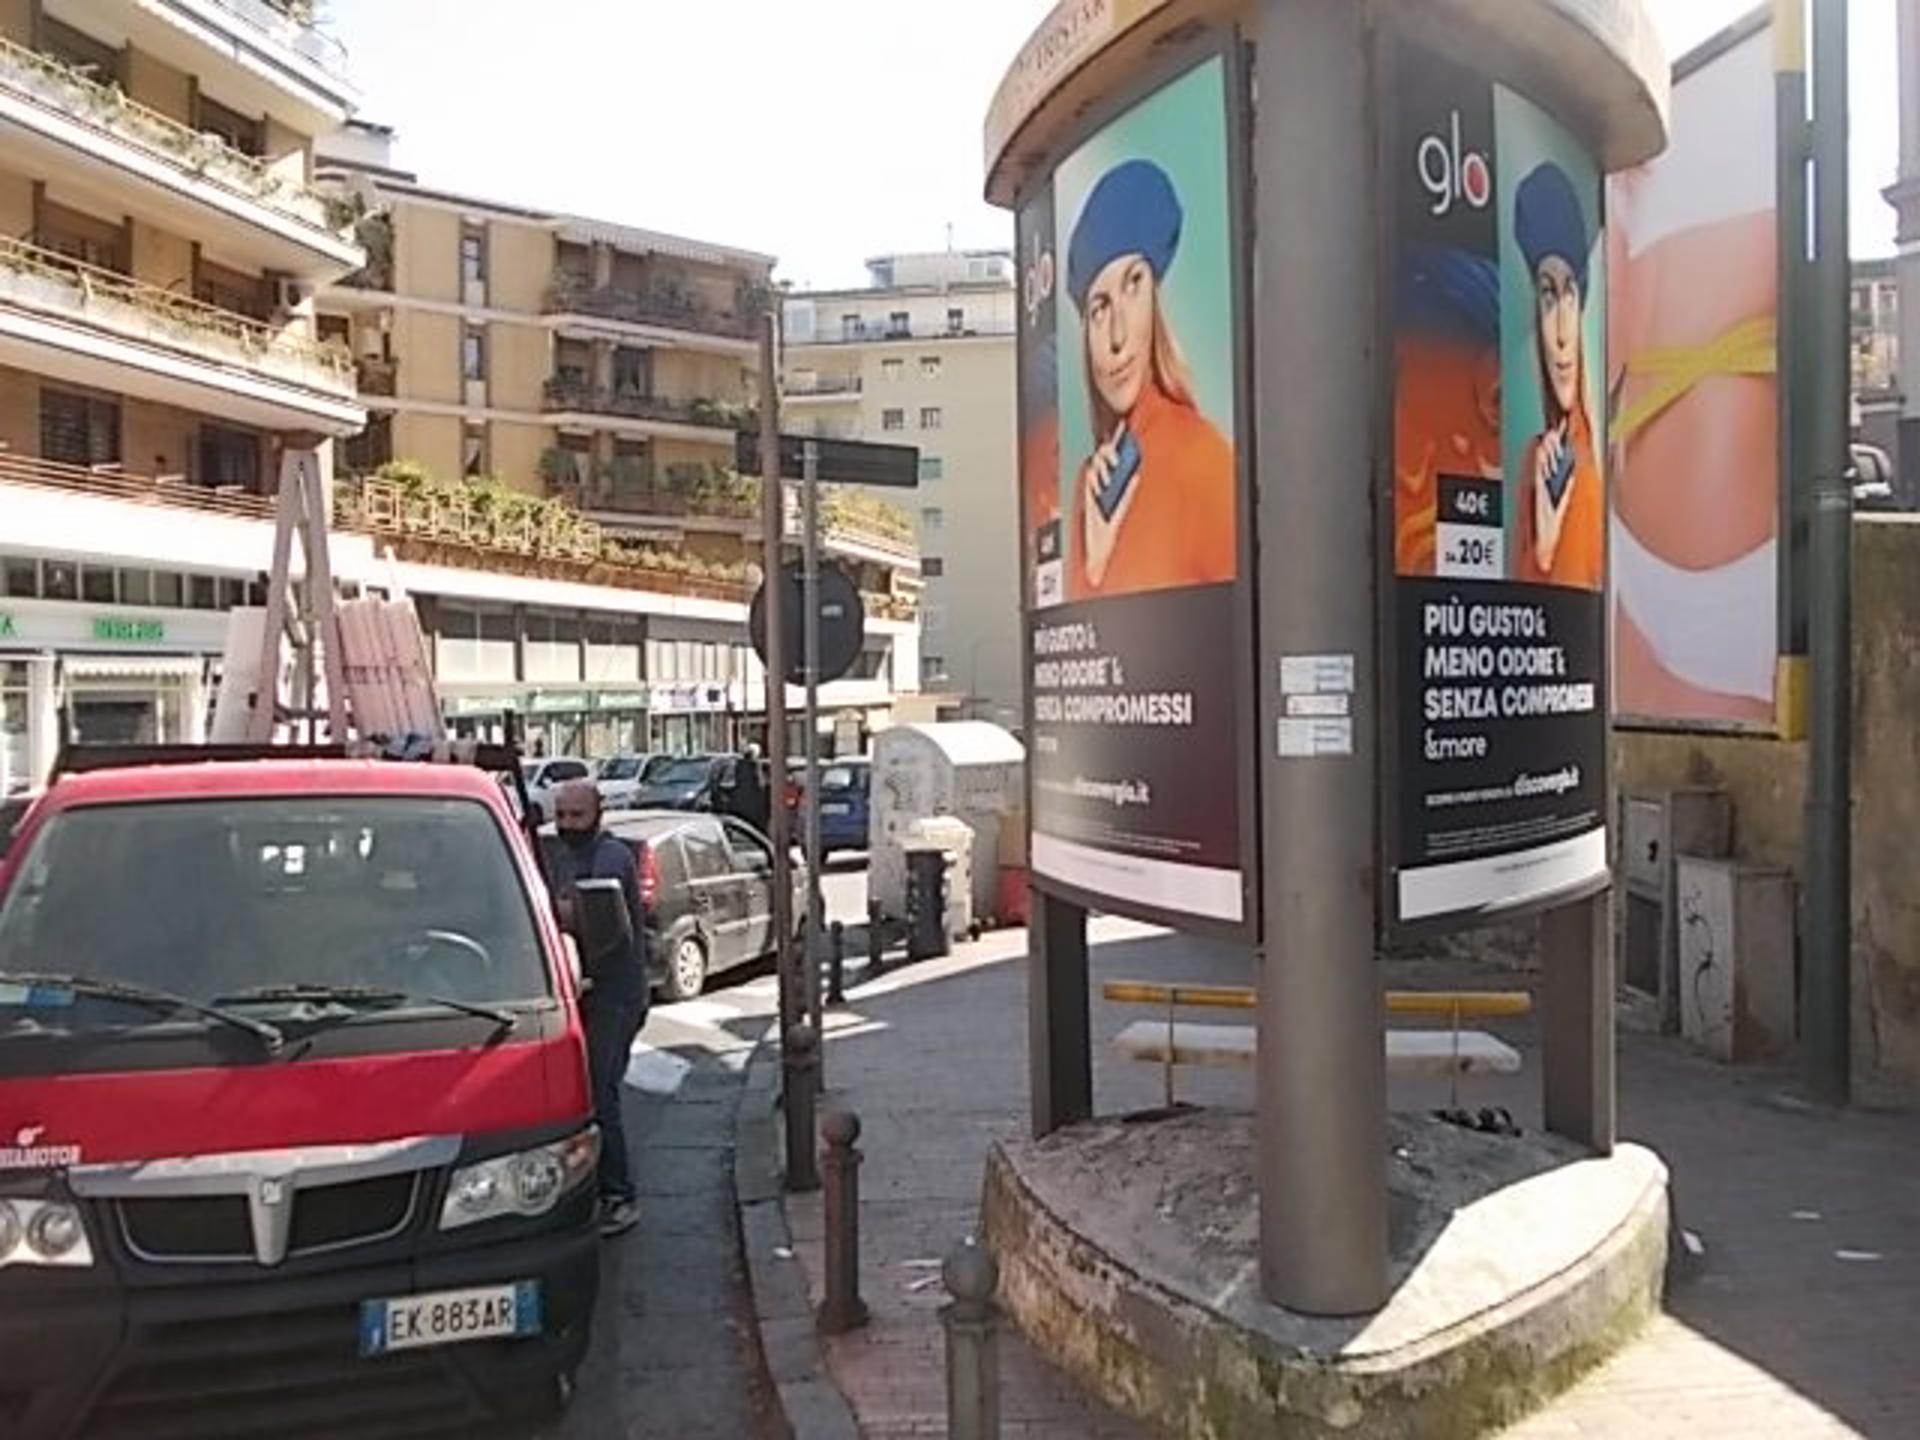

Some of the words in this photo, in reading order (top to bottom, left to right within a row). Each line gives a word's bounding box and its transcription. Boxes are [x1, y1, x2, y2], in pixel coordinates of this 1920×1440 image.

[1419, 109, 1490, 214] glo
[1459, 538, 1494, 566] 20€
[1424, 595, 1465, 637] PIÙ
[1468, 605, 1533, 637] GUSTO
[1424, 647, 1494, 678] MENO
[1424, 687, 1498, 721] SENZA
[390, 1305, 421, 1341] EK
[431, 1297, 512, 1334] 883AR
